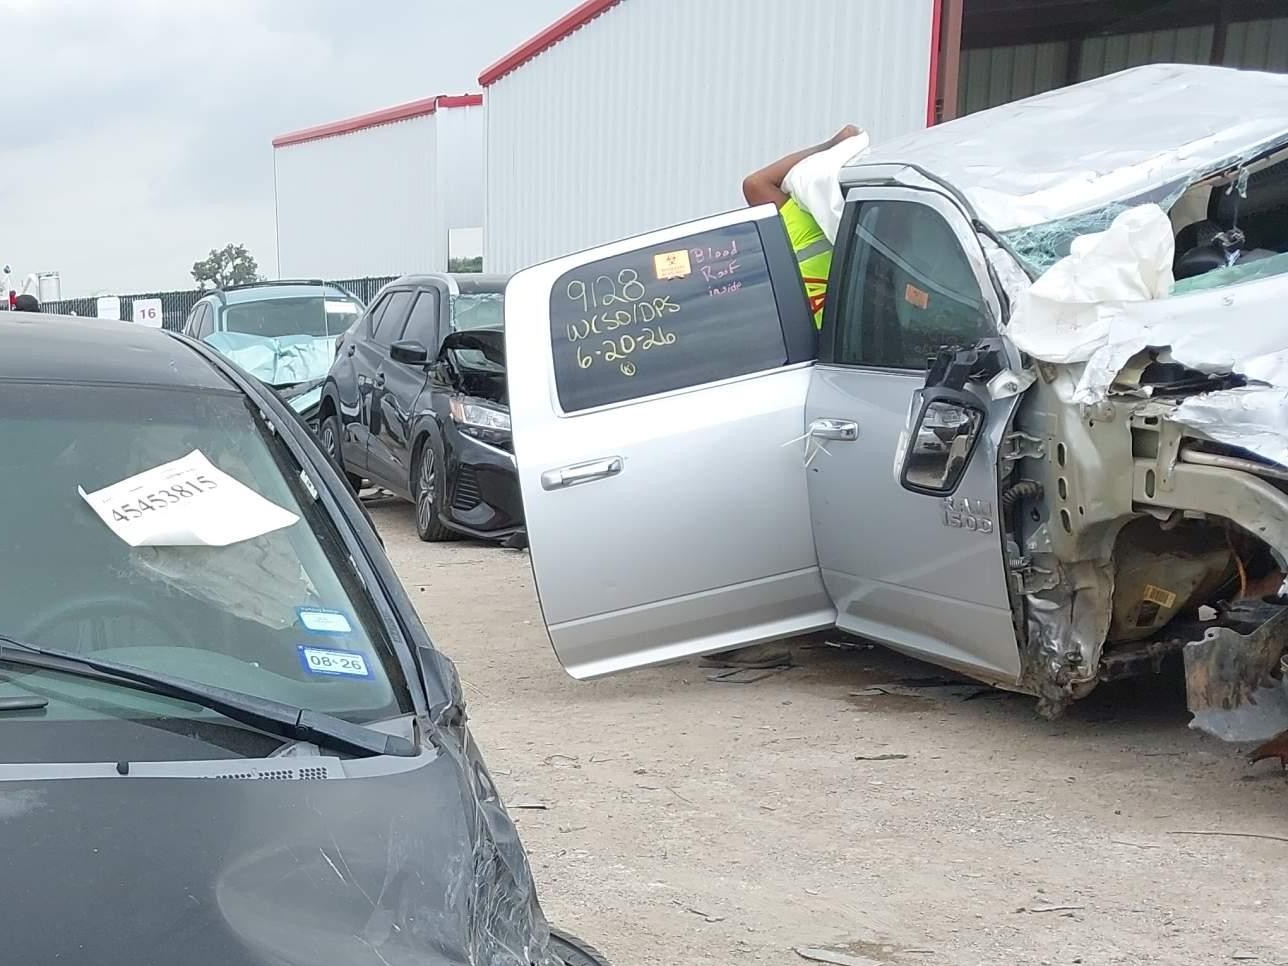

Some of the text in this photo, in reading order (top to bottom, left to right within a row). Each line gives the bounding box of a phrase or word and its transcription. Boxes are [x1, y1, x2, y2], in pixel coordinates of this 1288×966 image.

[690, 240, 738, 263] Blood
[567, 268, 645, 312] 9128
[140, 308, 156, 320] 16
[577, 326, 676, 369] 6-20-26
[111, 475, 218, 523] 45453815
